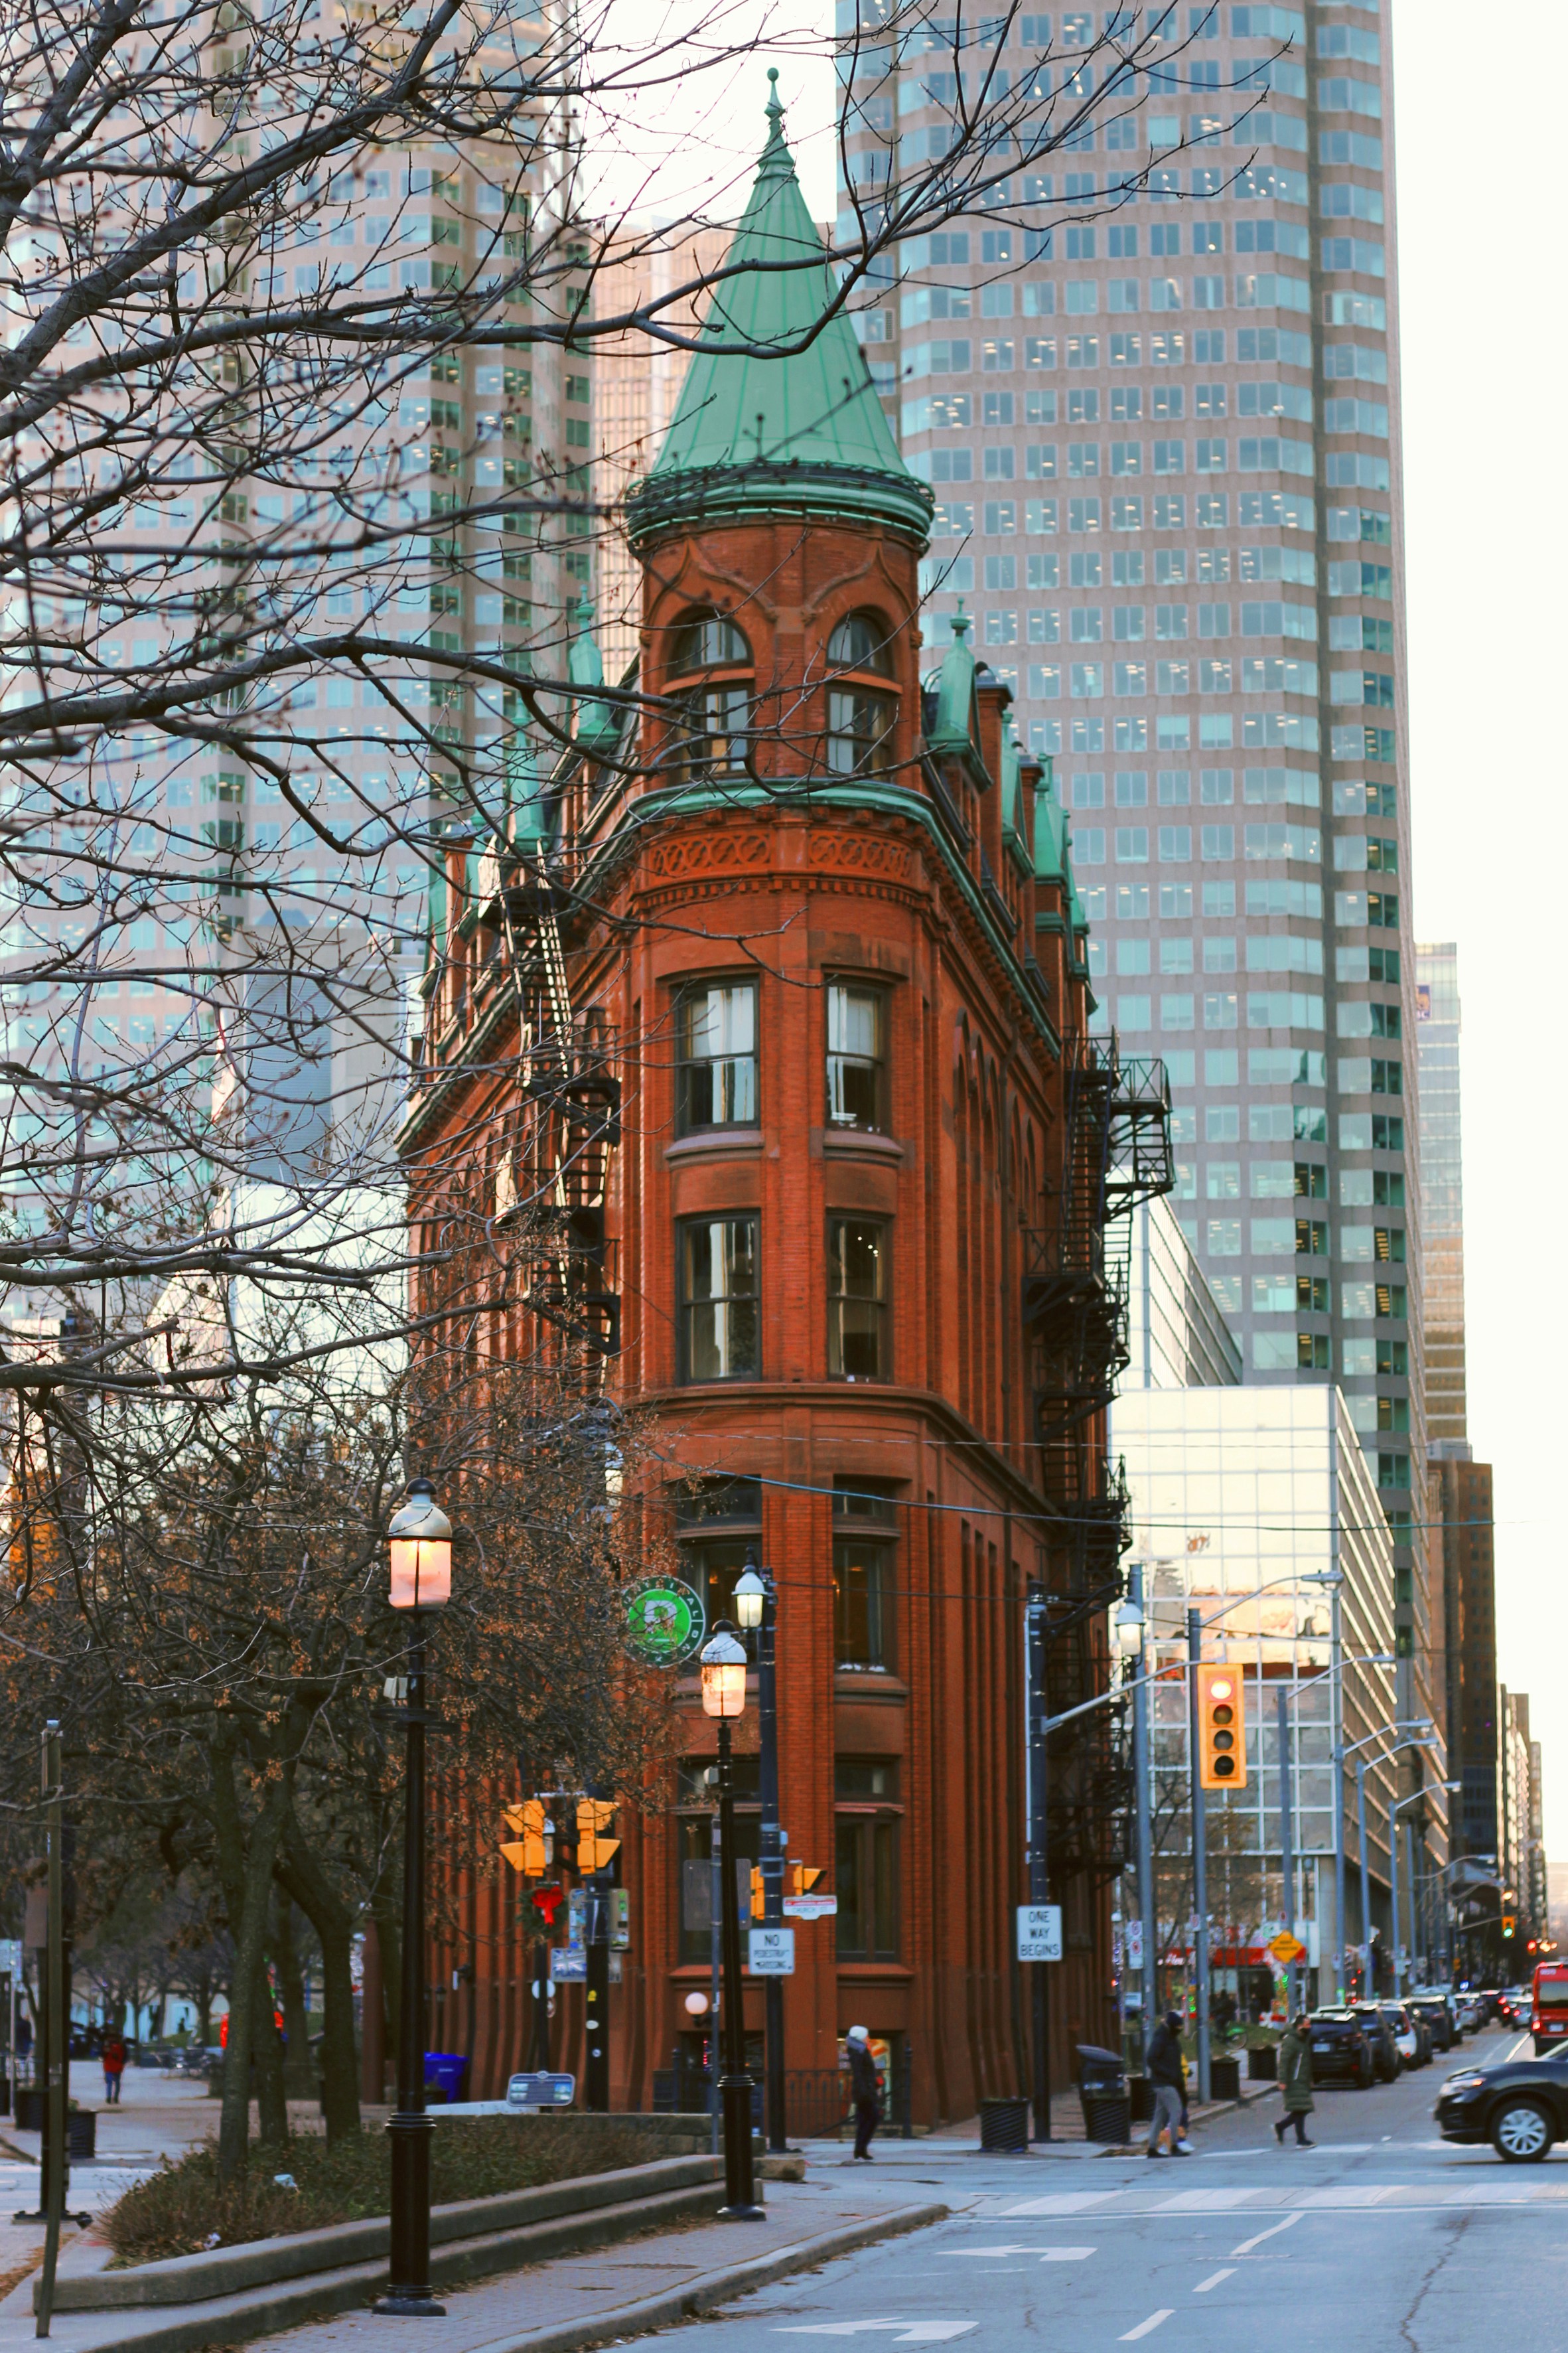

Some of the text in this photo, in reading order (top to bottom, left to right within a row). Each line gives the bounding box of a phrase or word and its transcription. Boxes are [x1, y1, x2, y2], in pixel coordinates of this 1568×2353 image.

[1029, 1911, 1050, 1923] ONE
[1030, 1928, 1050, 1939] WAY
[764, 1934, 780, 1946] NO
[1021, 1943, 1059, 1956] BEGINS
